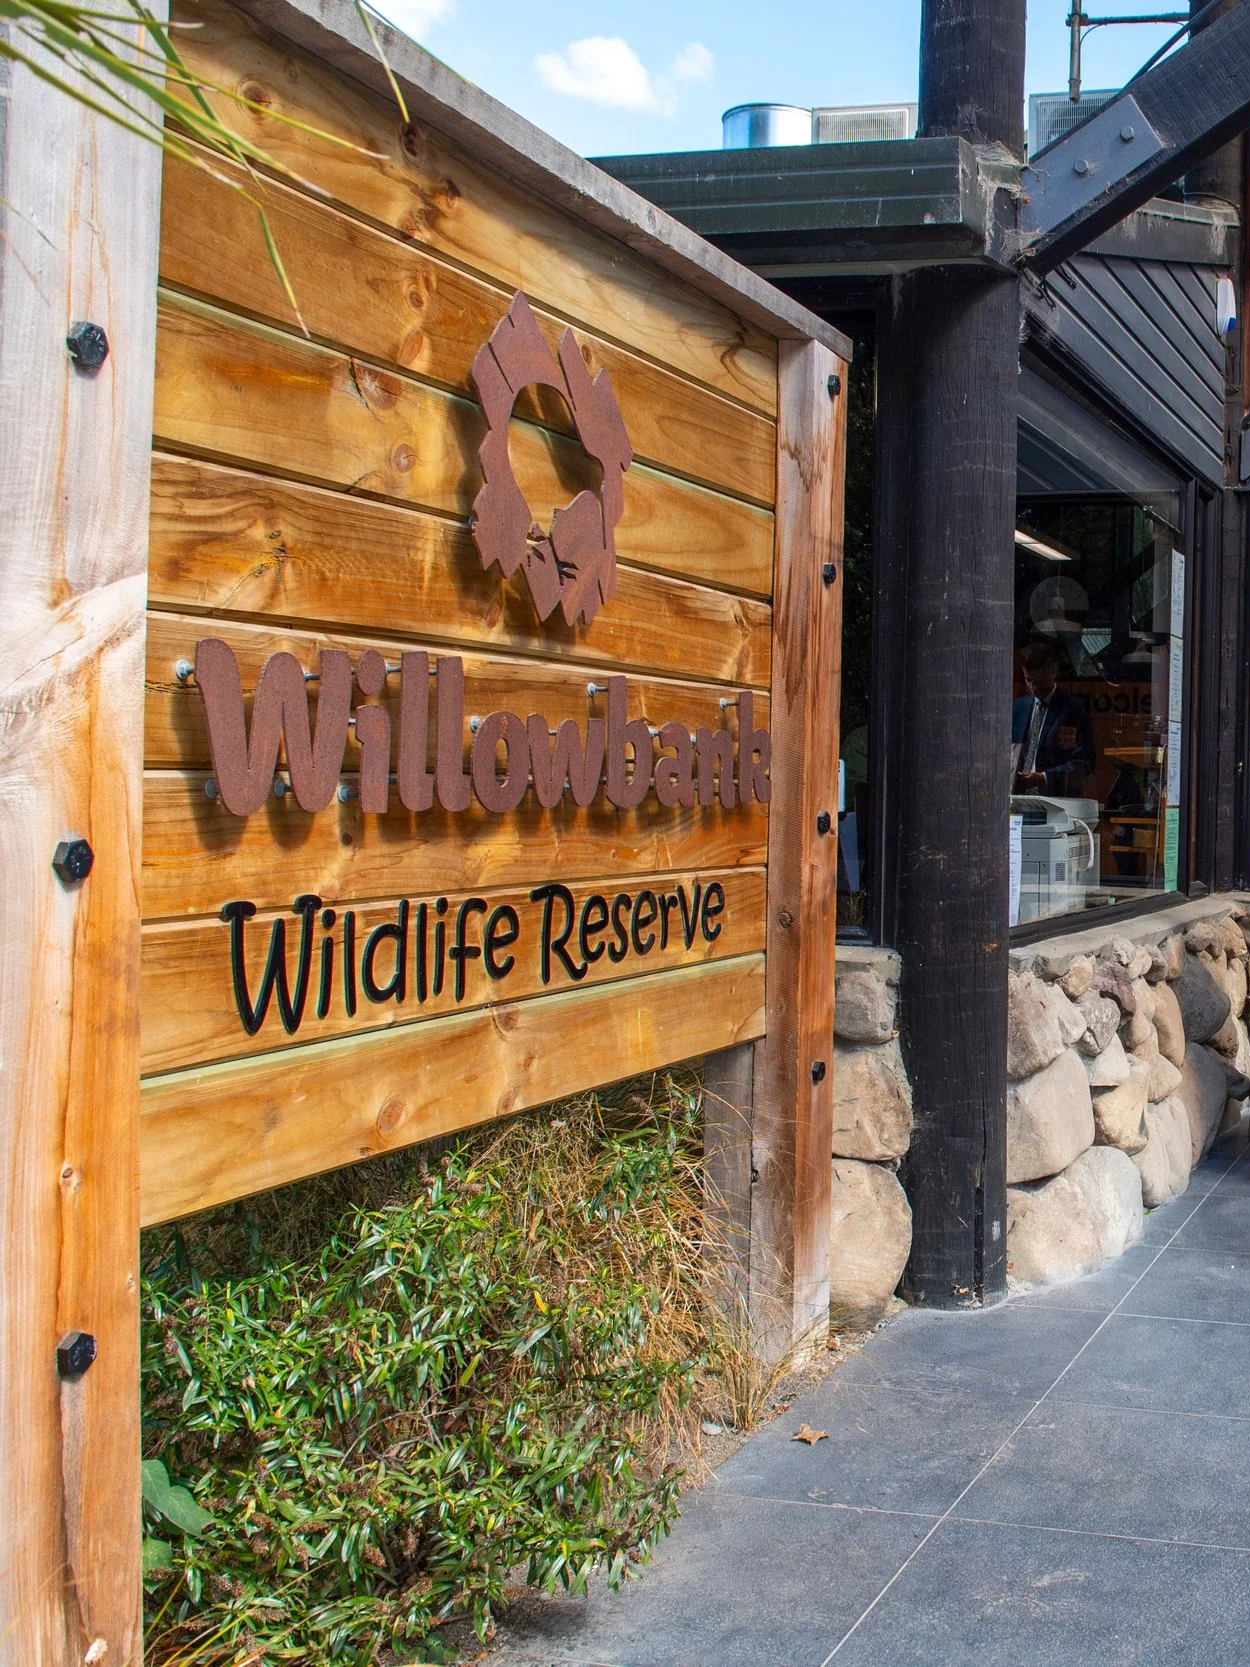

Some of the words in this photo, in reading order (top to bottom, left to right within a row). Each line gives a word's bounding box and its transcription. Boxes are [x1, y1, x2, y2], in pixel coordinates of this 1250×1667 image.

[195, 638, 772, 816] Willowbank
[220, 895, 519, 1036] Wildlife
[530, 881, 725, 983] Reserve
